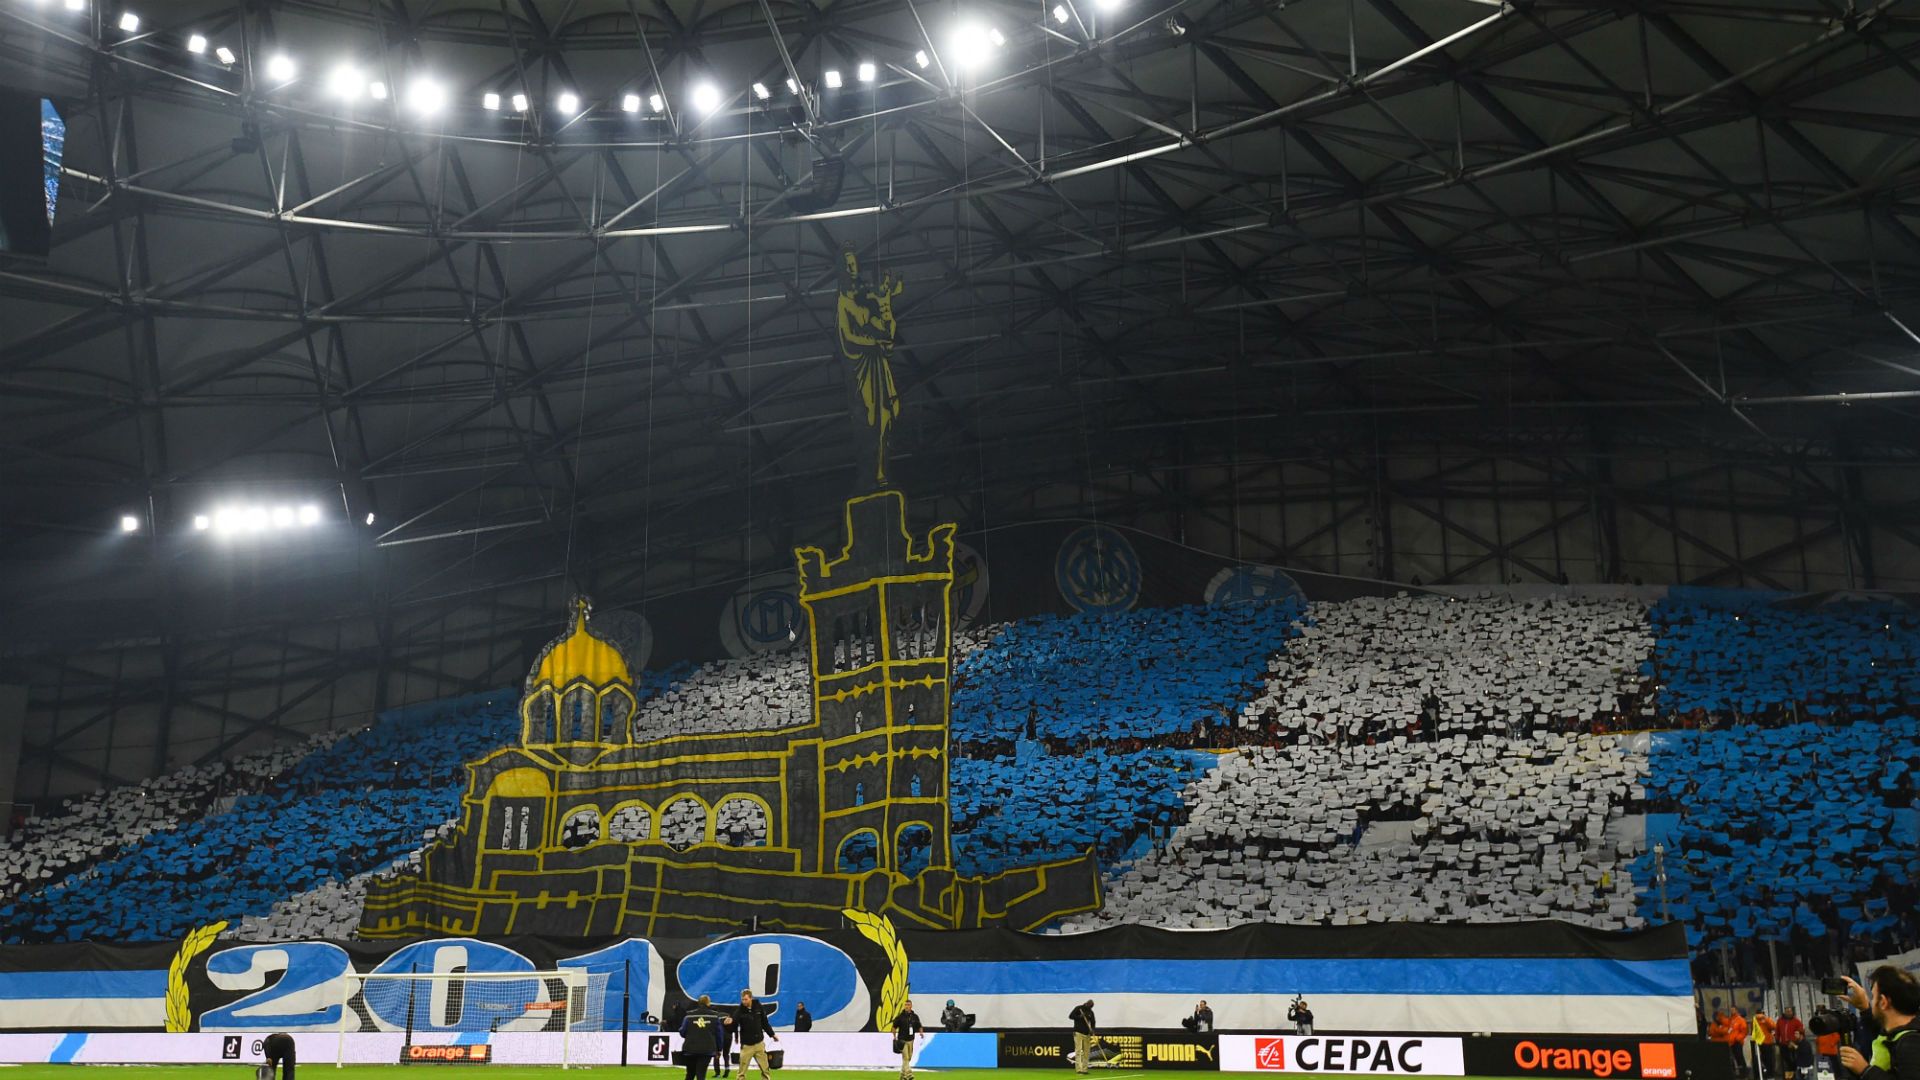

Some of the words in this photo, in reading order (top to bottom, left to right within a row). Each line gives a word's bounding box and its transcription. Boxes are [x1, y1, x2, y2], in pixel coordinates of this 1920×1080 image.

[410, 1046, 464, 1061] Orange
[1147, 1043, 1196, 1061] PUMA
[1295, 1038, 1423, 1073] CEPAC
[1514, 1041, 1633, 1076] Orange
